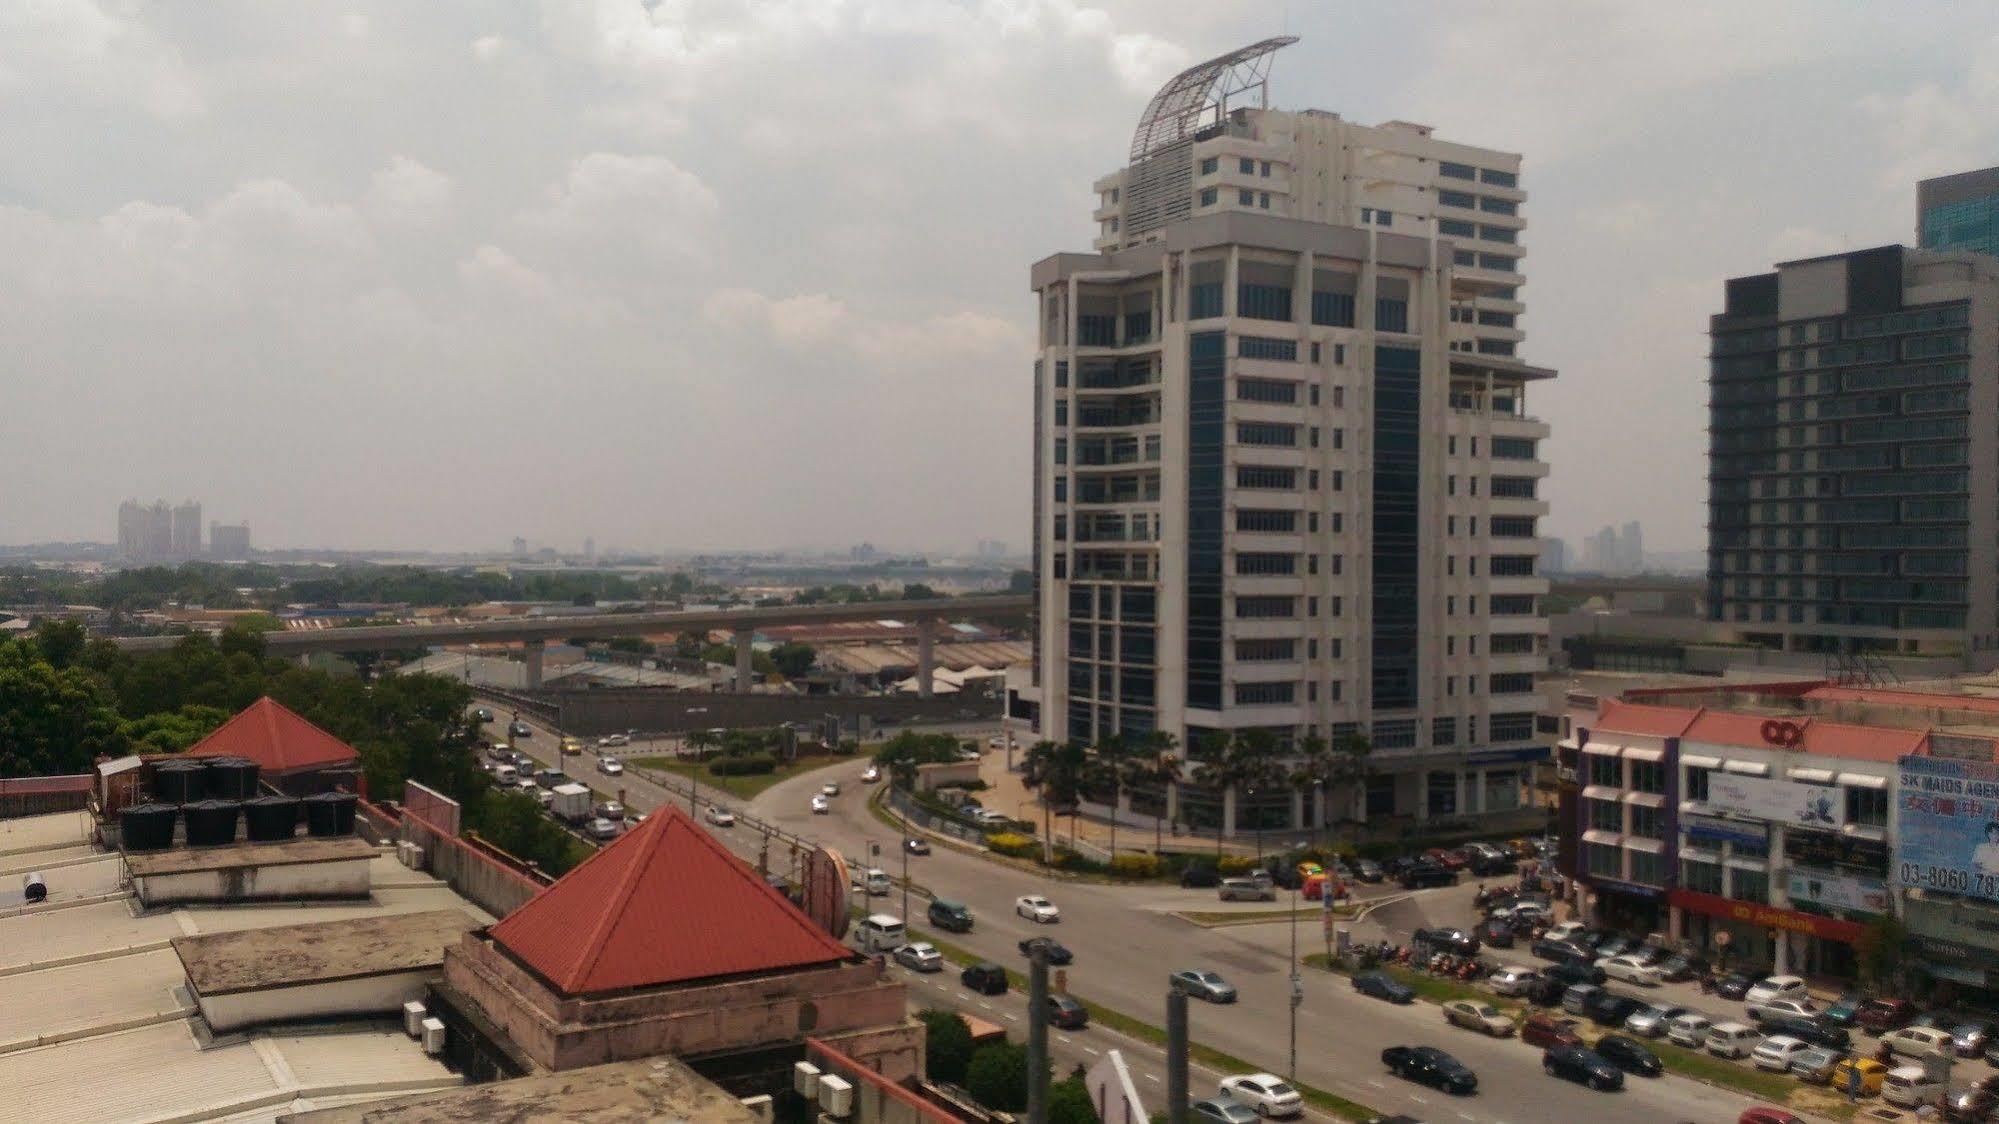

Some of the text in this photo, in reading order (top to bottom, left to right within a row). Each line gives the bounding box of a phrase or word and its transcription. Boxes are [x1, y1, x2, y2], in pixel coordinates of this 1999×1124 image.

[1922, 776, 1962, 794] MAIDS
[1901, 862, 1999, 899] 03-8060 78
